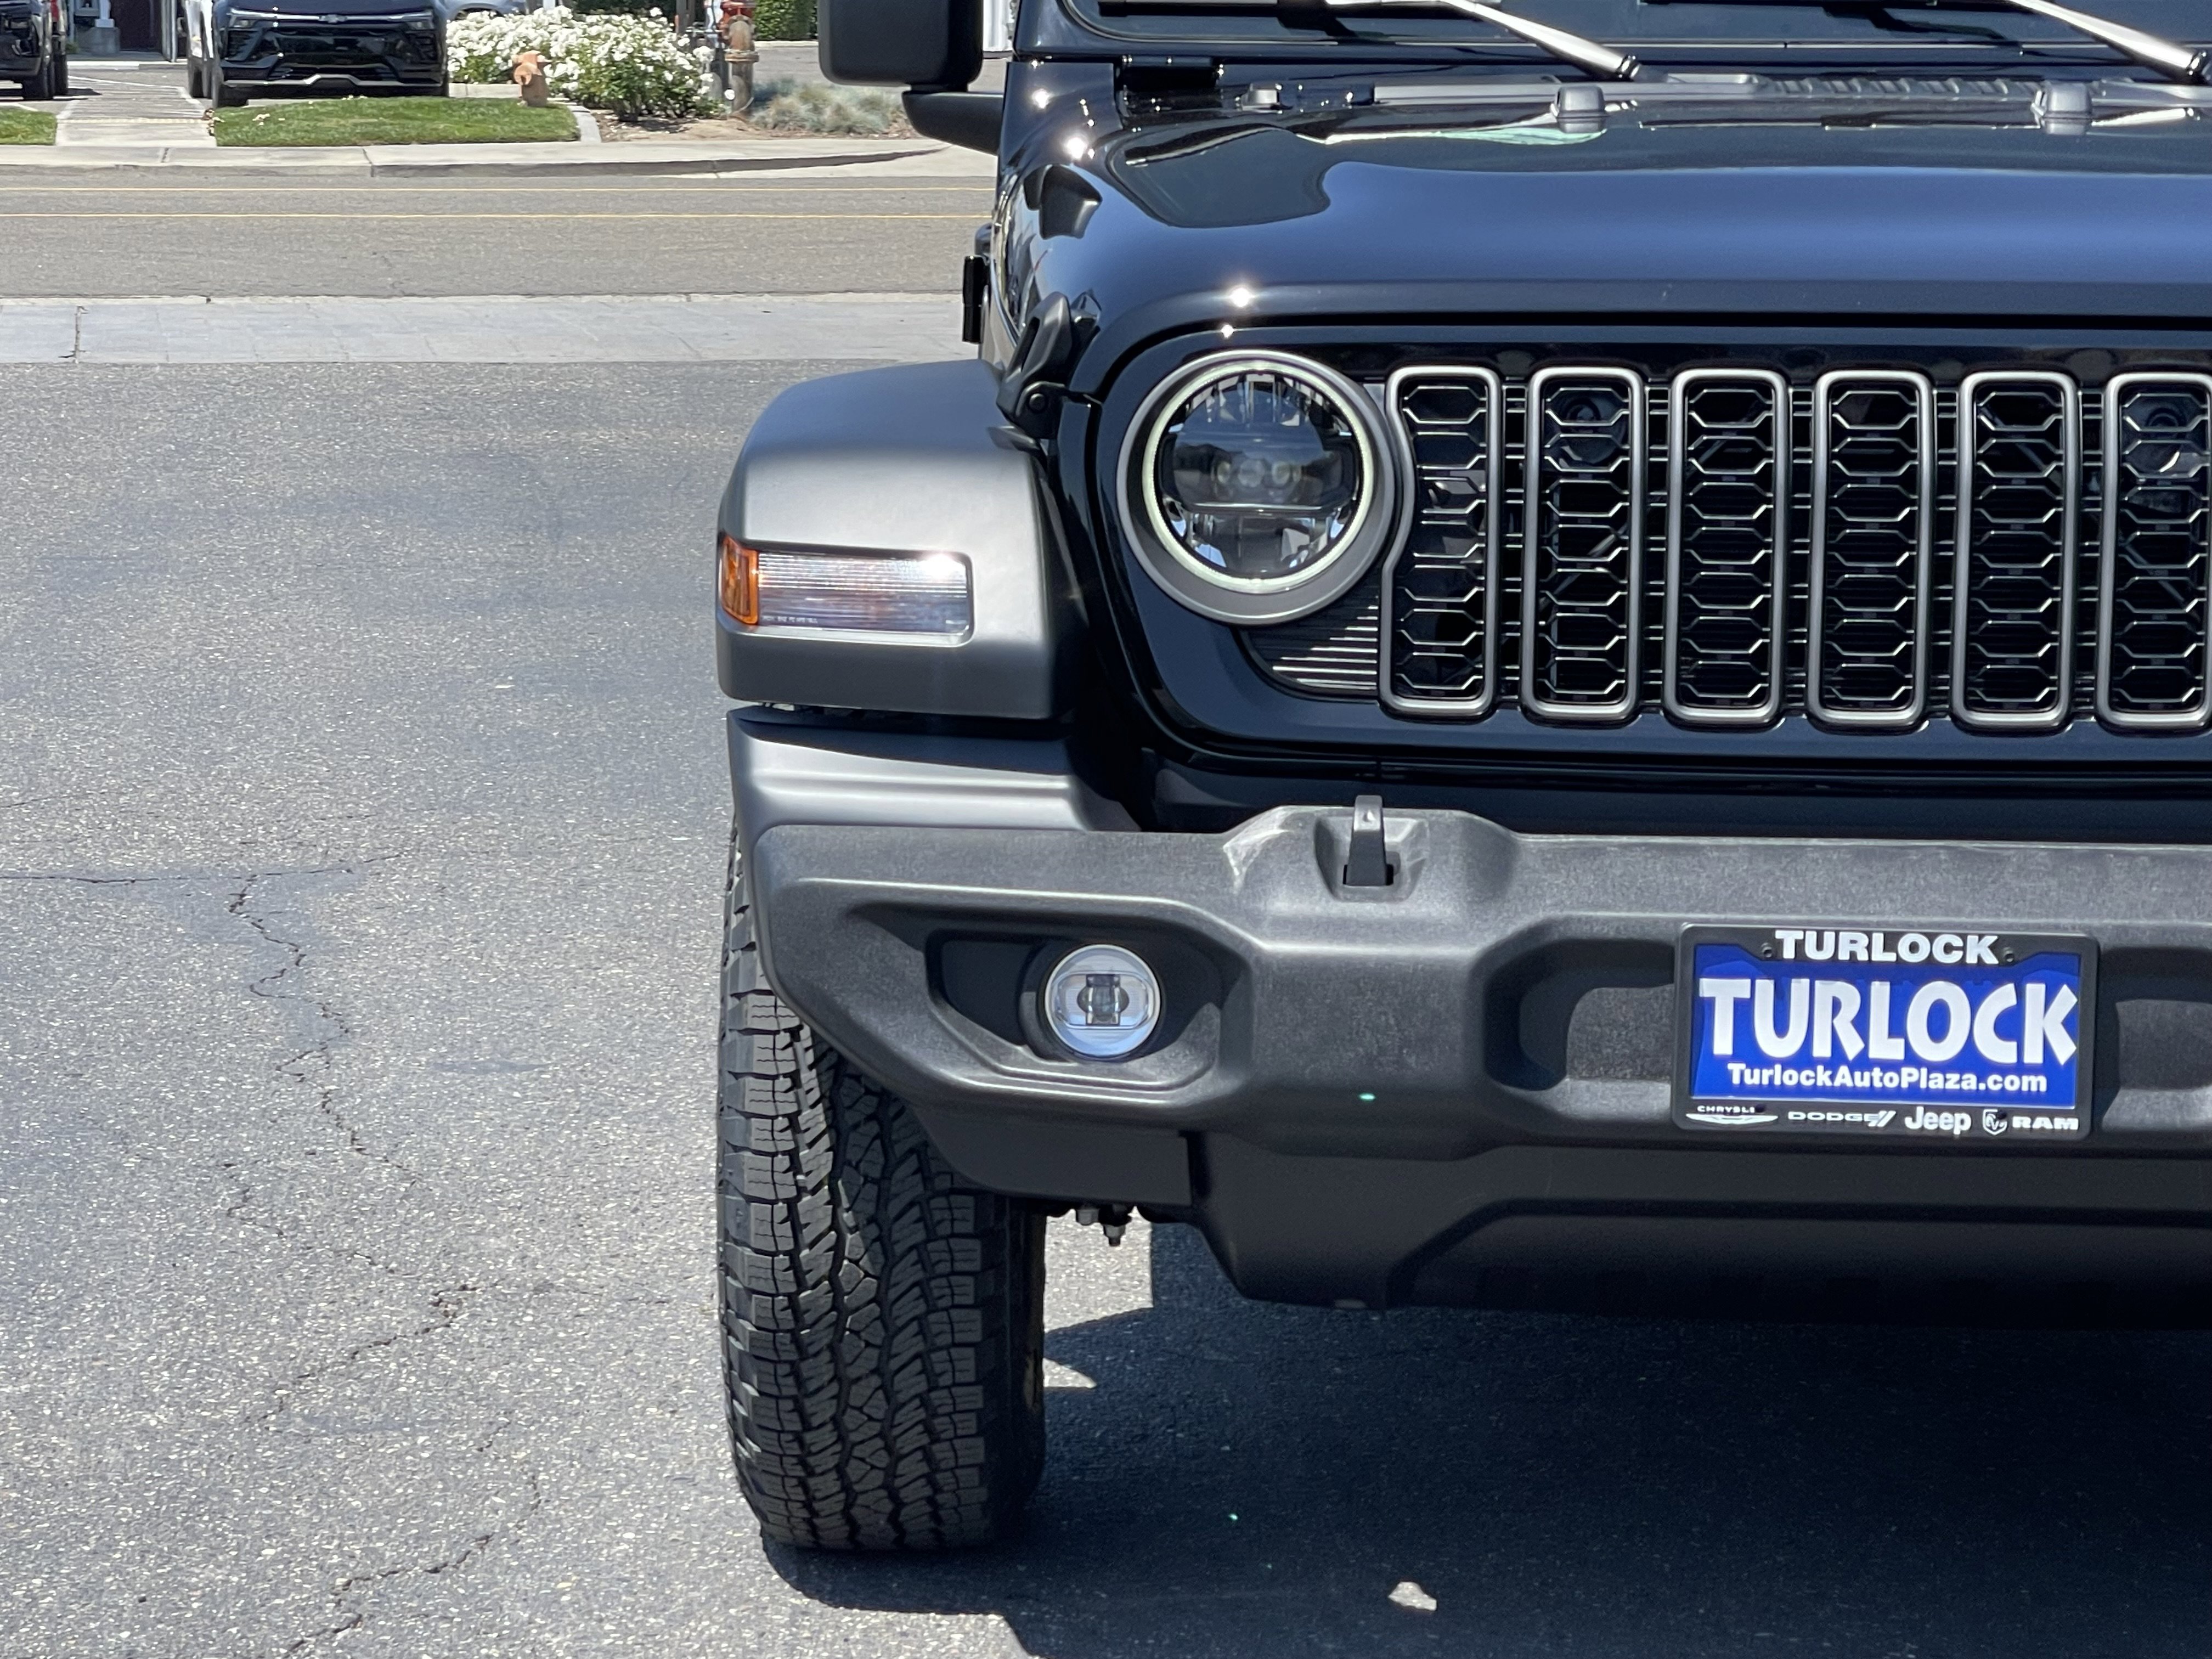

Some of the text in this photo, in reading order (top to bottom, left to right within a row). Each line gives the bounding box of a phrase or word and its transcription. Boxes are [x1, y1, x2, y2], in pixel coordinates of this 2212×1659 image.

[1775, 929, 1999, 965] TURLOCK
[1699, 978, 2078, 1066] TURLOCK
[1727, 1063, 2047, 1092] TurlockAutoPlaza.com
[1787, 1111, 1882, 1122] DODGE
[1904, 1106, 1972, 1135] Jeep
[2012, 1115, 2079, 1130] RAM
